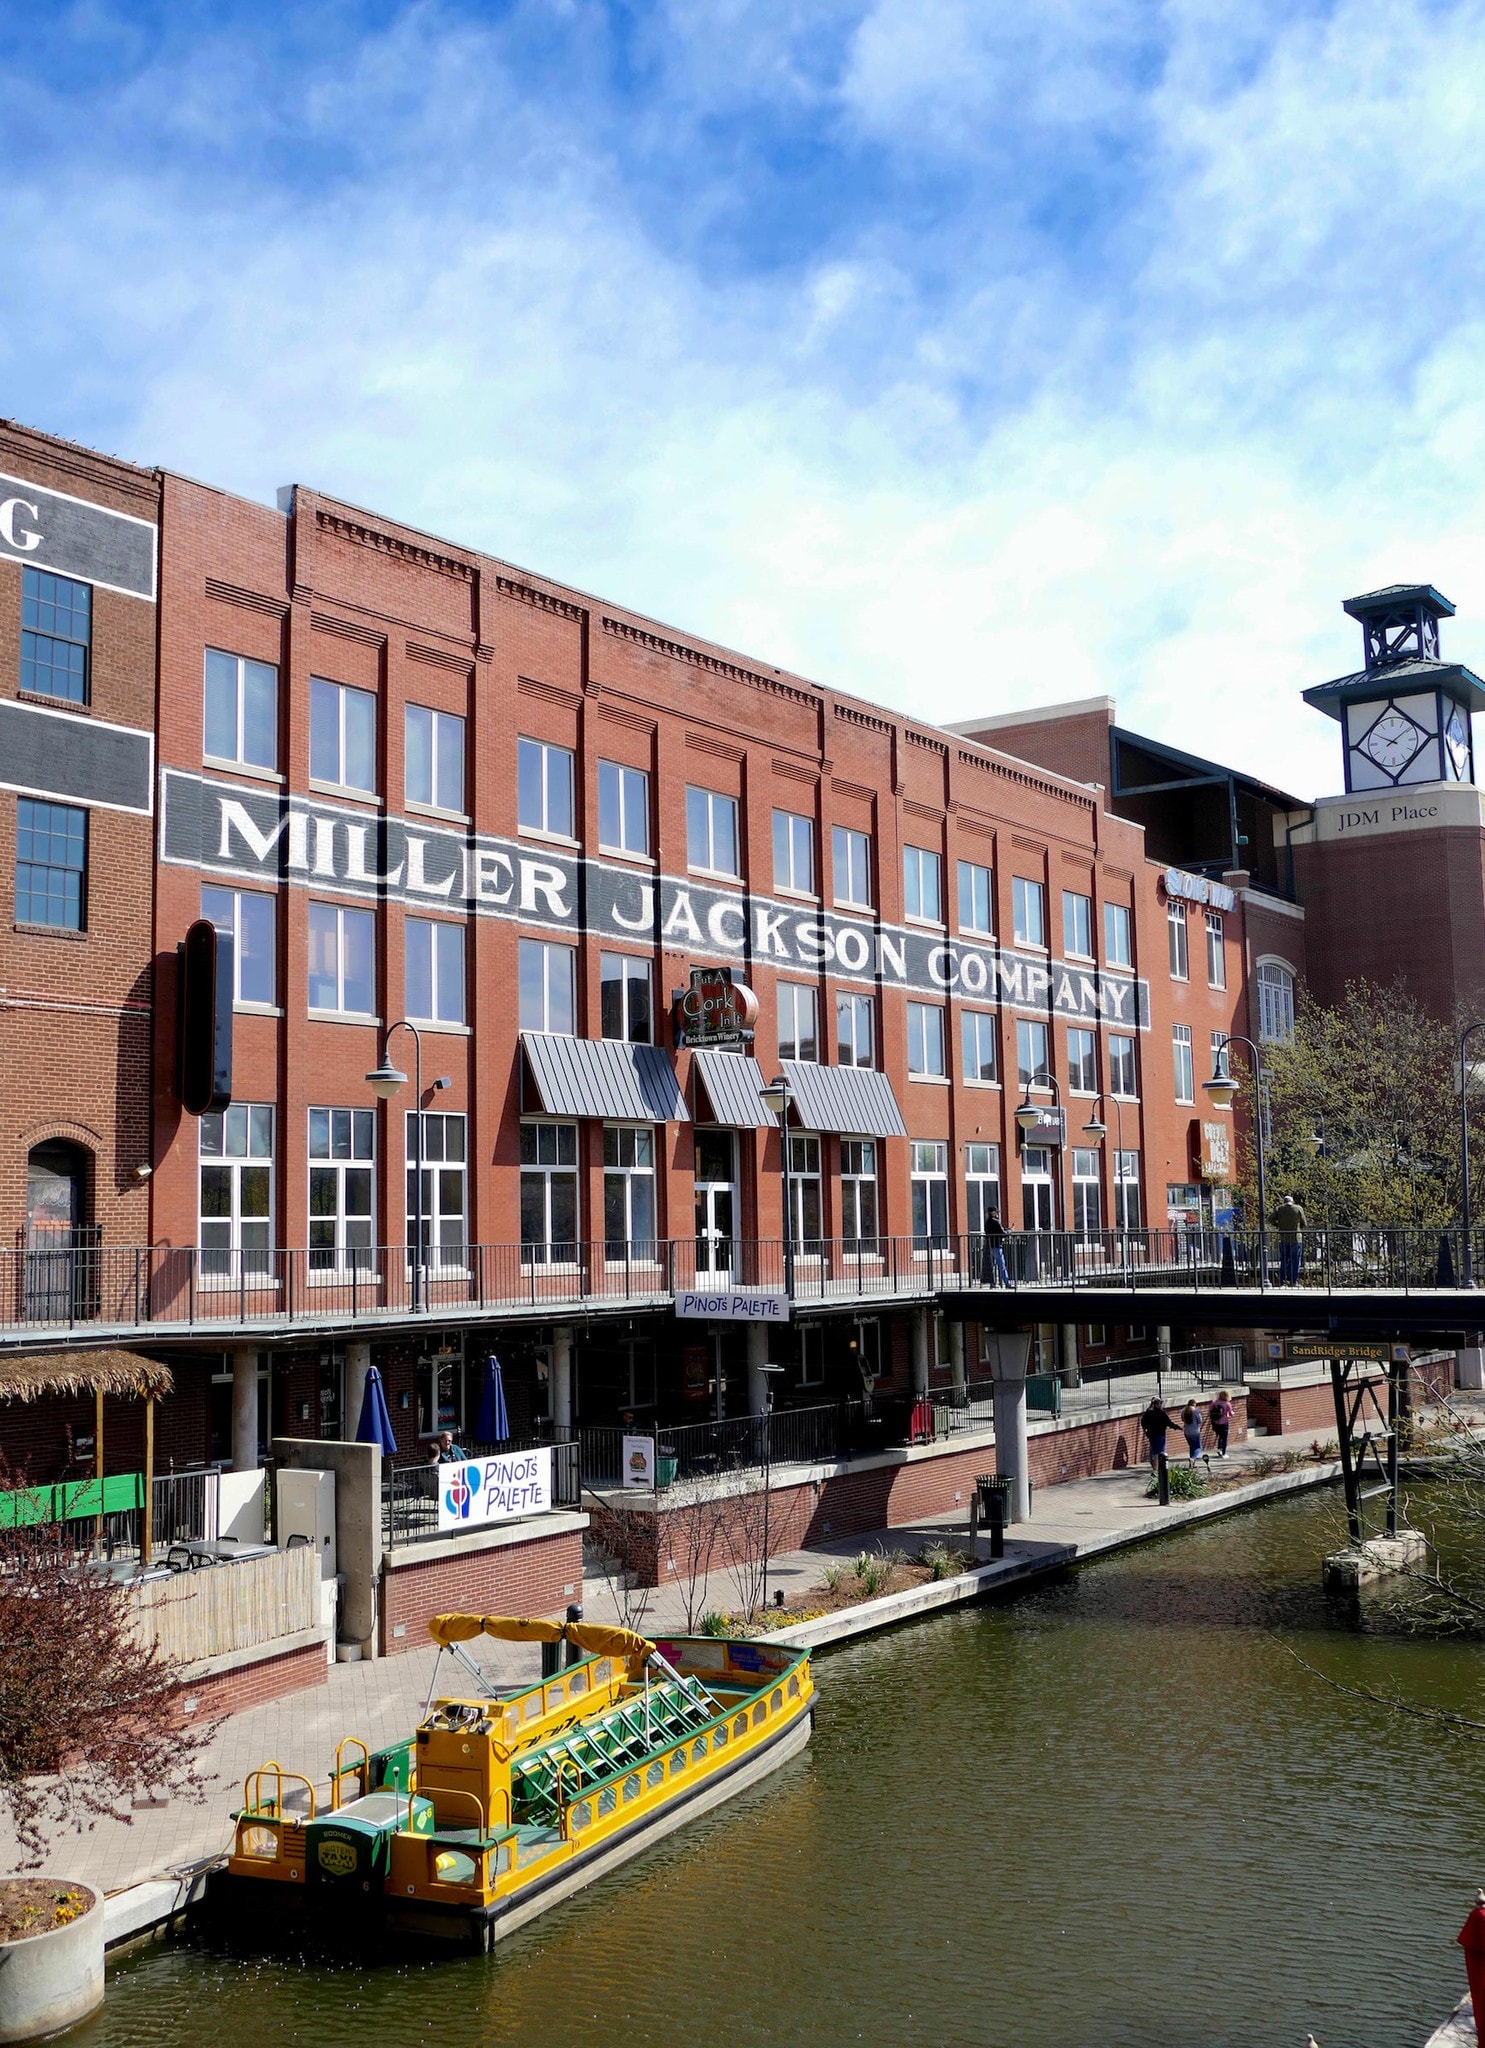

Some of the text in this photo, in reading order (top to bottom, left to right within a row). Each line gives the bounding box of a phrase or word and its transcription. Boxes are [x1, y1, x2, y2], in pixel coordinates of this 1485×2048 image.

[1338, 806, 1438, 831] JDM Place
[216, 798, 1130, 1019] MILLER JACKSON COMPANY
[693, 971, 725, 987] Put A
[683, 987, 733, 1016] Cork
[720, 1011, 741, 1028] In It
[685, 1032, 741, 1044] Bricktown Winery
[732, 1297, 780, 1316] PALETTE
[1292, 1346, 1383, 1358] SandRidge Bridge
[486, 1482, 543, 1516] PALETTE
